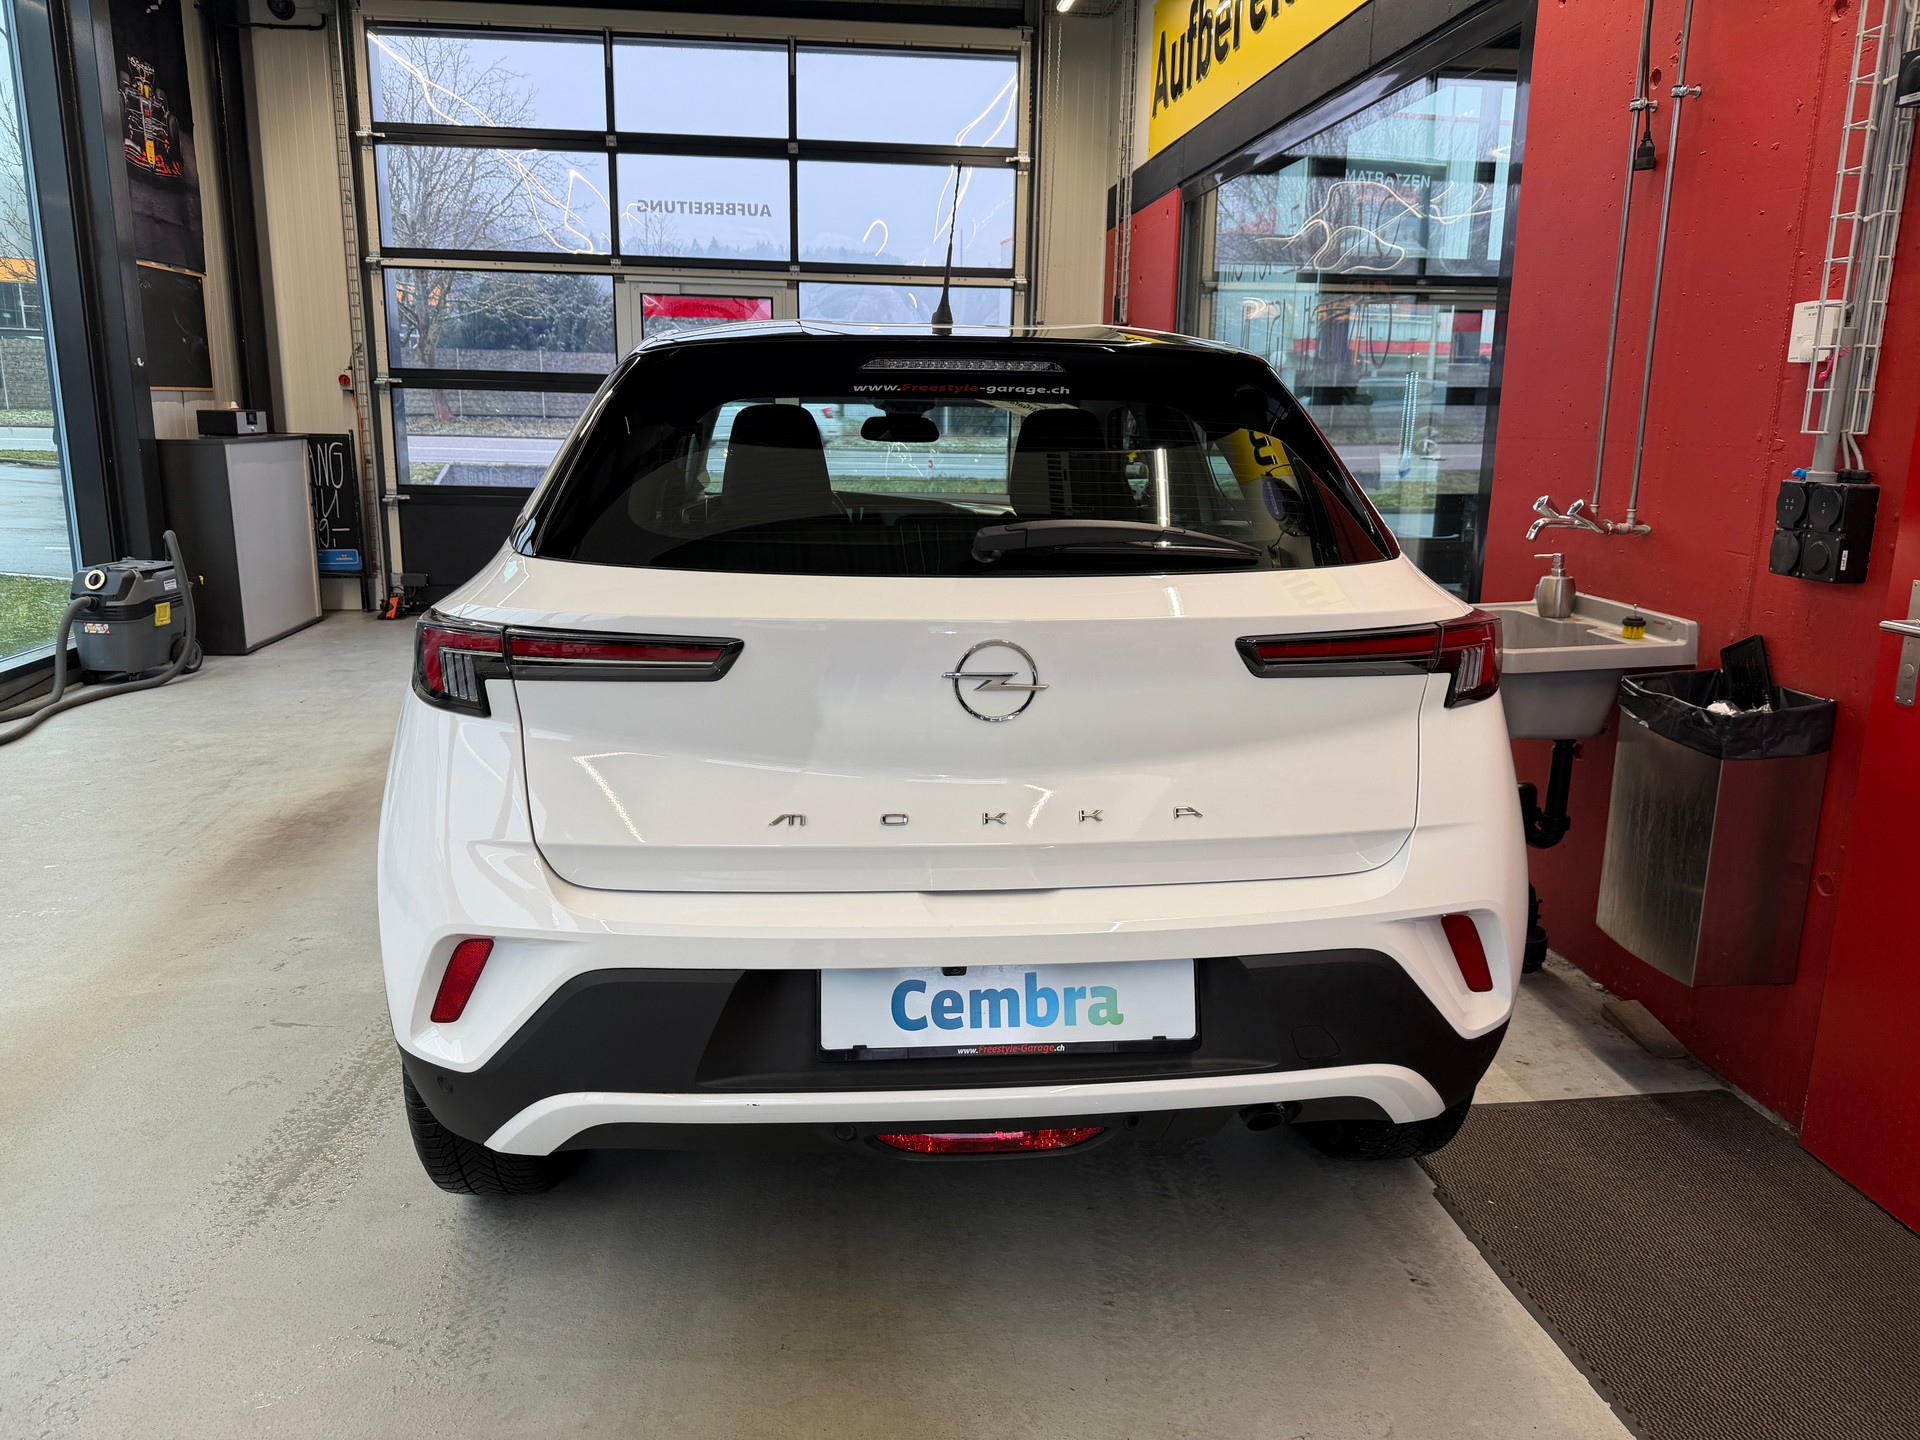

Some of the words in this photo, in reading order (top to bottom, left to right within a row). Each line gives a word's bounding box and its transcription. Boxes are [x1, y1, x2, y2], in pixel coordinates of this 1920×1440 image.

[1152, 0, 1296, 119] Aufbere
[853, 383, 1070, 395] www.Freestyle-garage.ch
[769, 805, 1203, 827] MOKKA
[891, 972, 1124, 1031] Cembra
[957, 1044, 1065, 1055] www.Freestyle-Garage.ch
